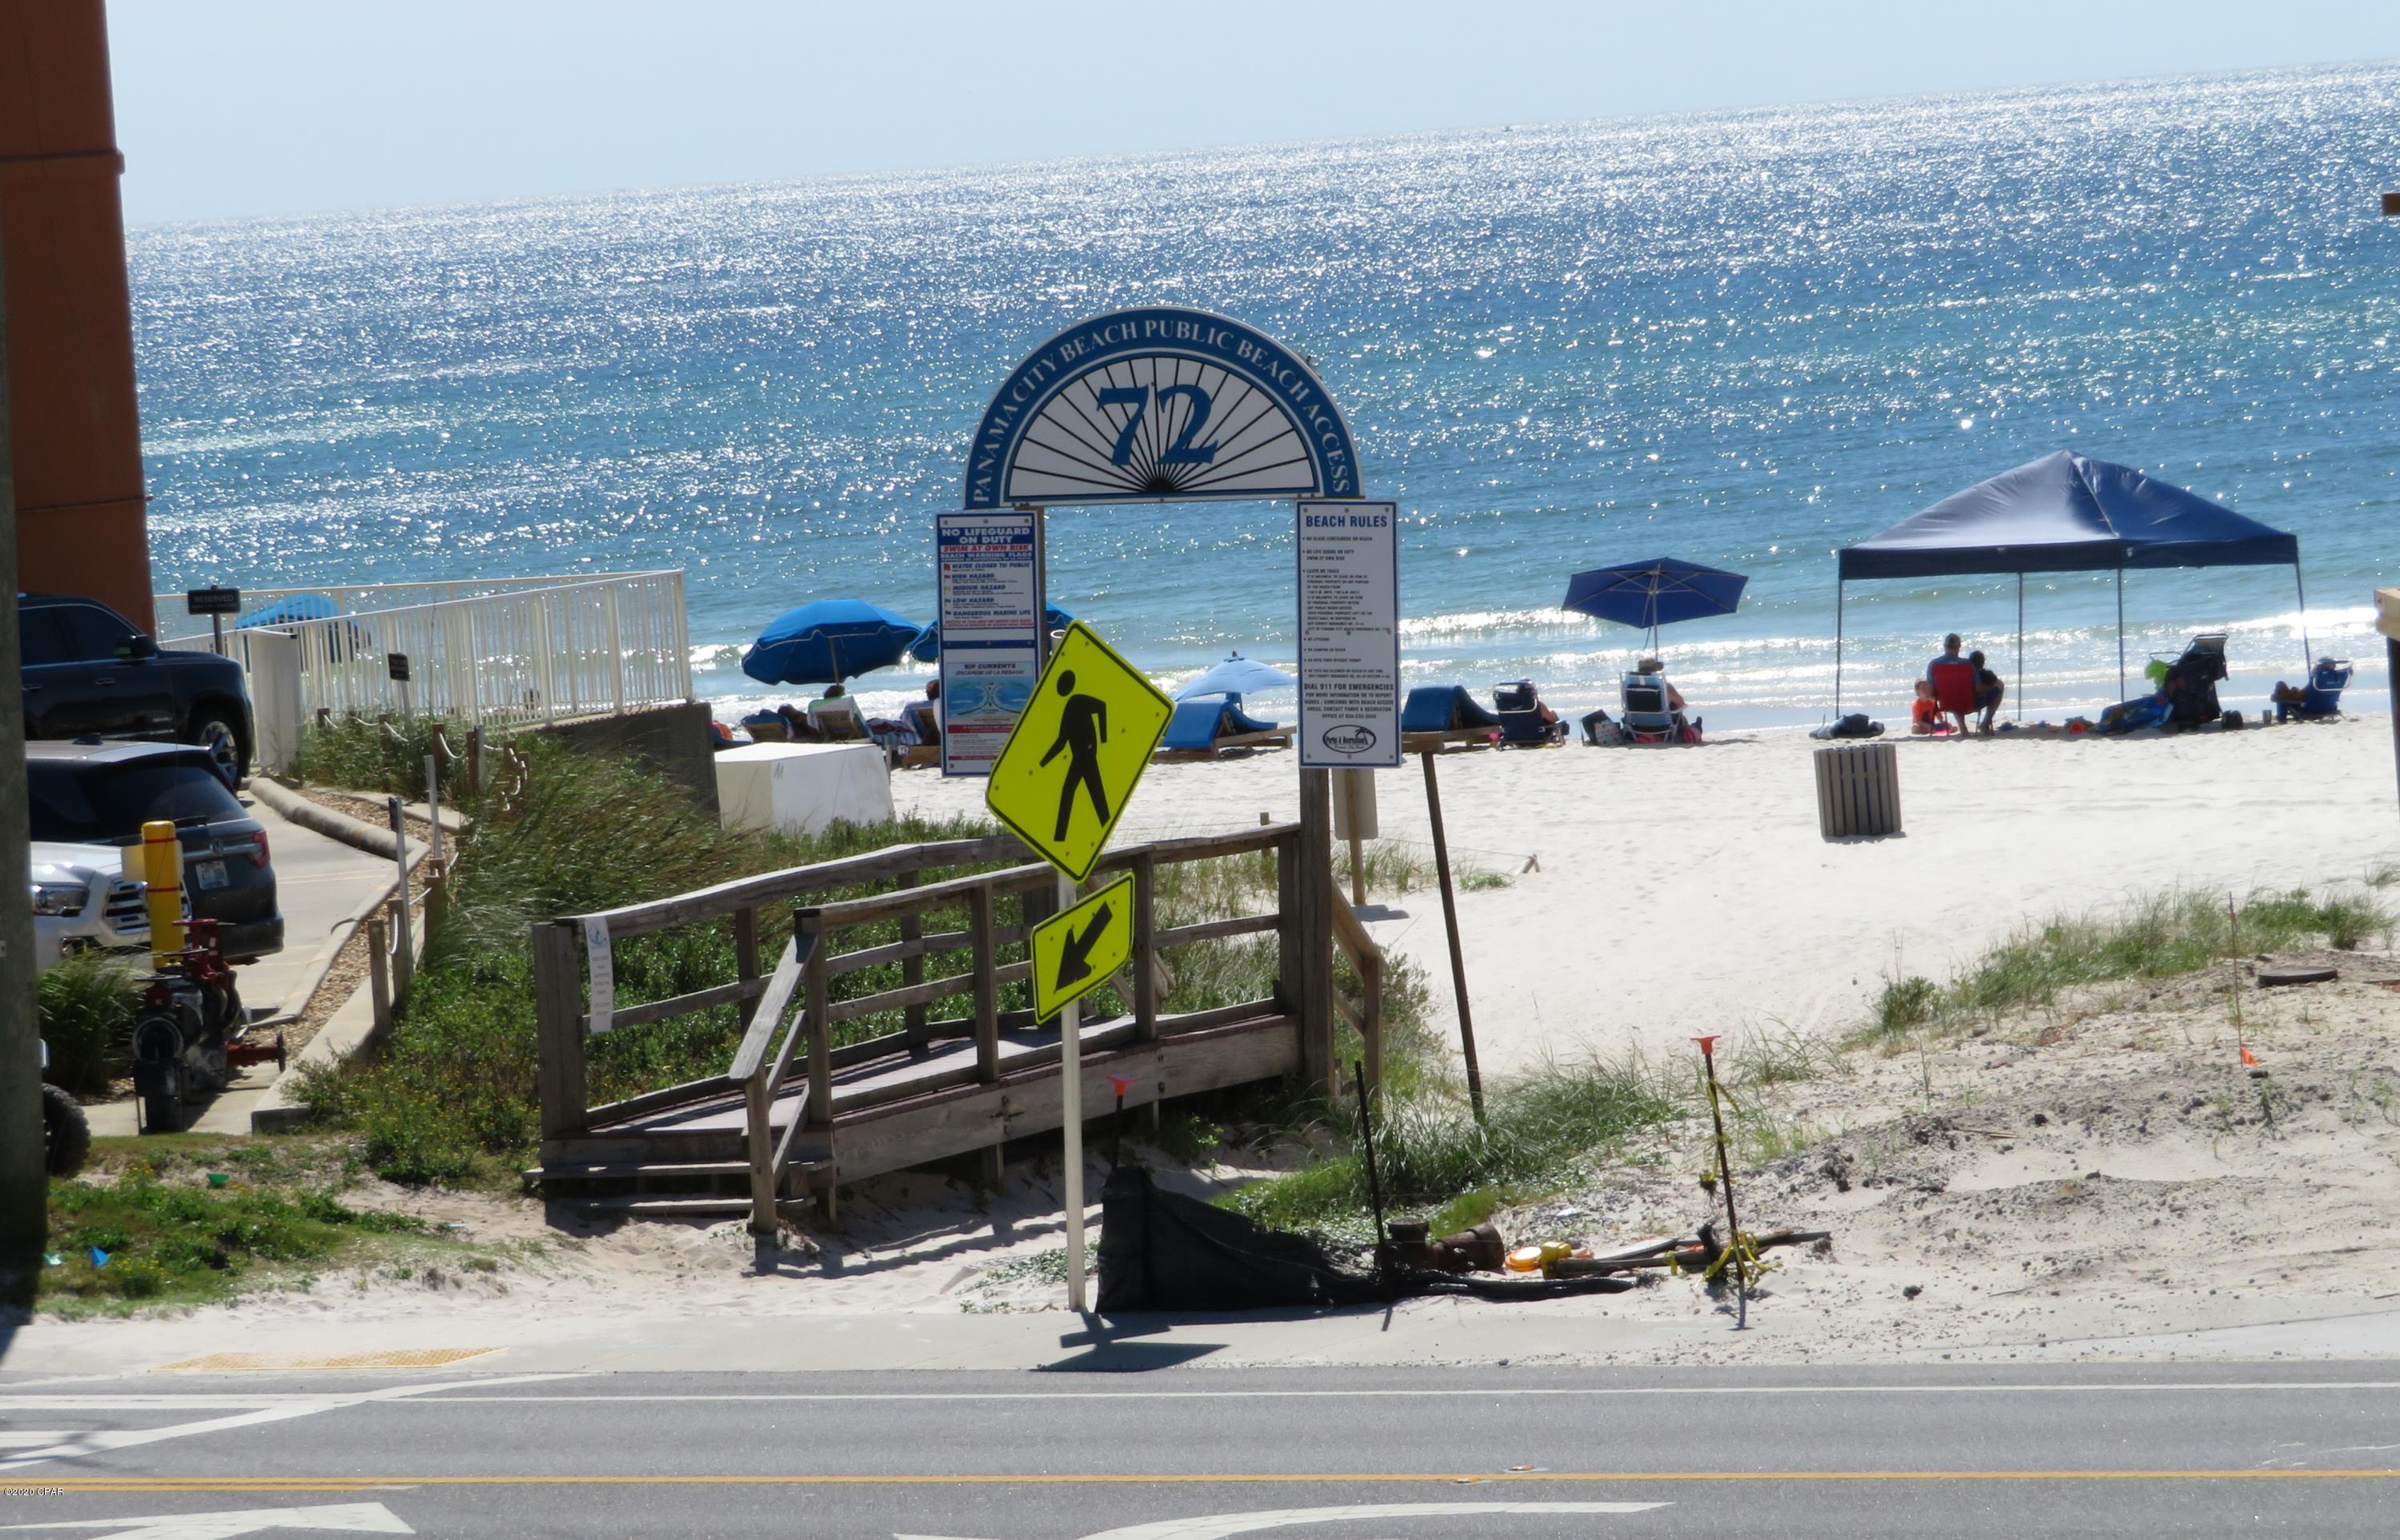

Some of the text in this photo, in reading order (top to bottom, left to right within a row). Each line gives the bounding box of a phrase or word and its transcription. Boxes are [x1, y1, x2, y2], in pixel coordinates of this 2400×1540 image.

[972, 319, 1350, 503] PANAMA CITY BEACH PUBLIC BEACH ACCESS
[1097, 383, 1219, 466] 72
[1306, 515, 1387, 527] BEACH RULES
[942, 527, 1030, 536] NO LIFEGUARD
[959, 536, 1013, 544] ON DUTY
